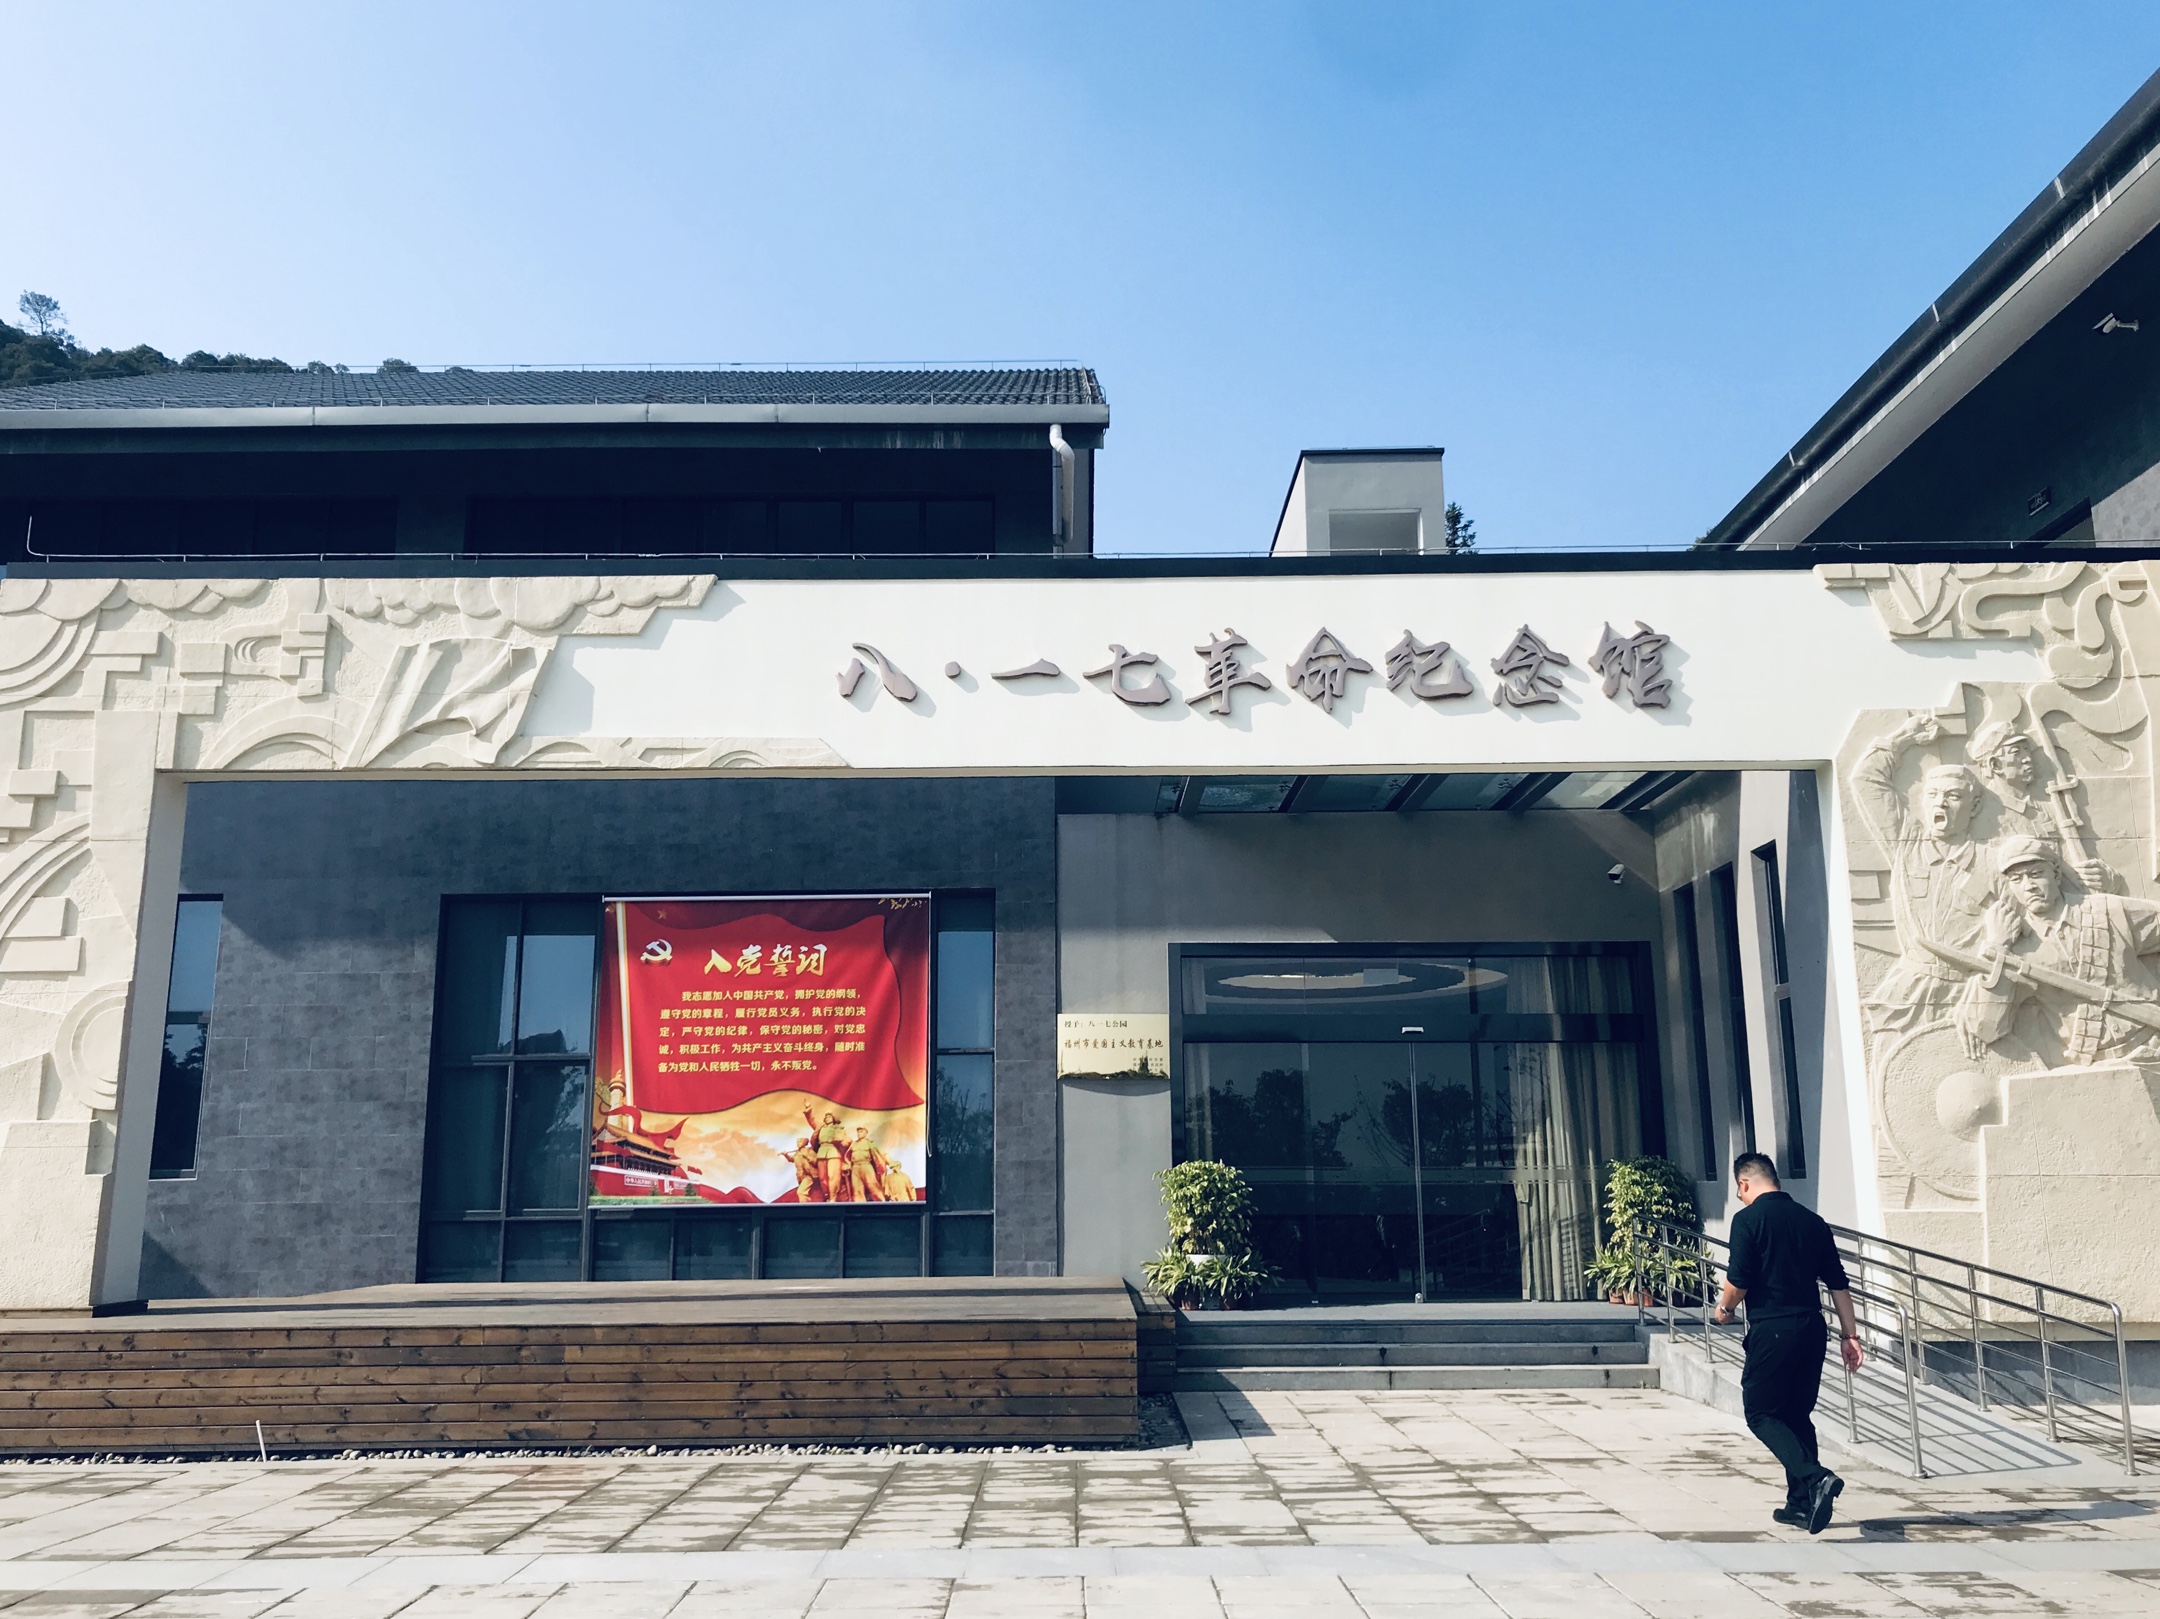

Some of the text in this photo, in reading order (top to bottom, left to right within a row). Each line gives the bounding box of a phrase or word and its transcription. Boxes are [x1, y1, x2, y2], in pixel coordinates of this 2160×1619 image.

[837, 620, 1673, 717] 八·一七革命纪念馆
[704, 943, 828, 977] 入党誓词
